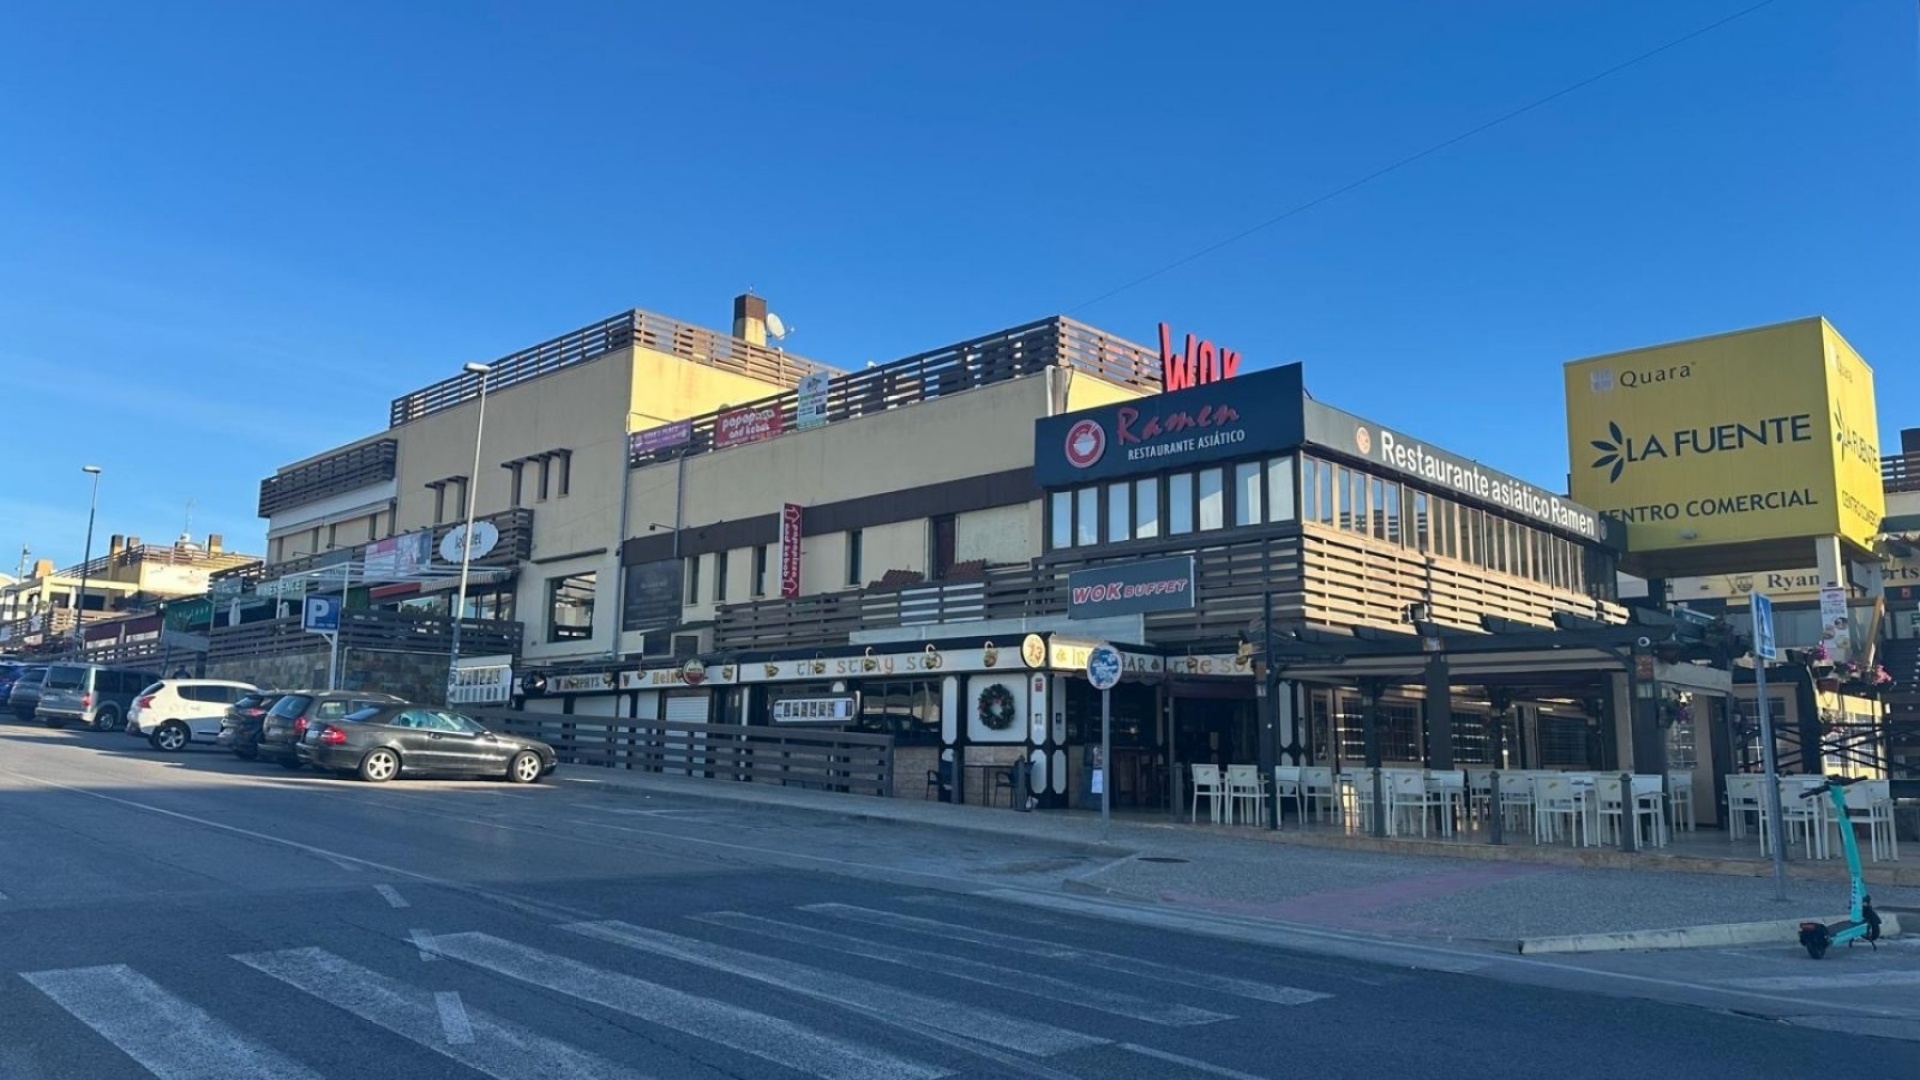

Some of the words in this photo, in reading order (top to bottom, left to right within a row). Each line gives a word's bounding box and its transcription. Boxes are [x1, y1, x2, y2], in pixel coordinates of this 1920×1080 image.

[1620, 363, 1692, 388] Quara
[1117, 405, 1240, 445] Ramen
[1626, 434, 1668, 462] LA
[1674, 413, 1813, 456] FUENTE
[1128, 438, 1195, 461] RESTAURANTE
[1198, 429, 1245, 450] ASIÁTICO
[1380, 431, 1489, 497] Restaurante
[1491, 480, 1549, 519] asiático
[1551, 496, 1594, 536] Ramen
[1598, 503, 1680, 524] ENTRO
[1686, 488, 1818, 517] COMERCIAL
[1072, 581, 1123, 604] WOK
[1123, 579, 1187, 598] BUFFET
[307, 599, 330, 626] P
